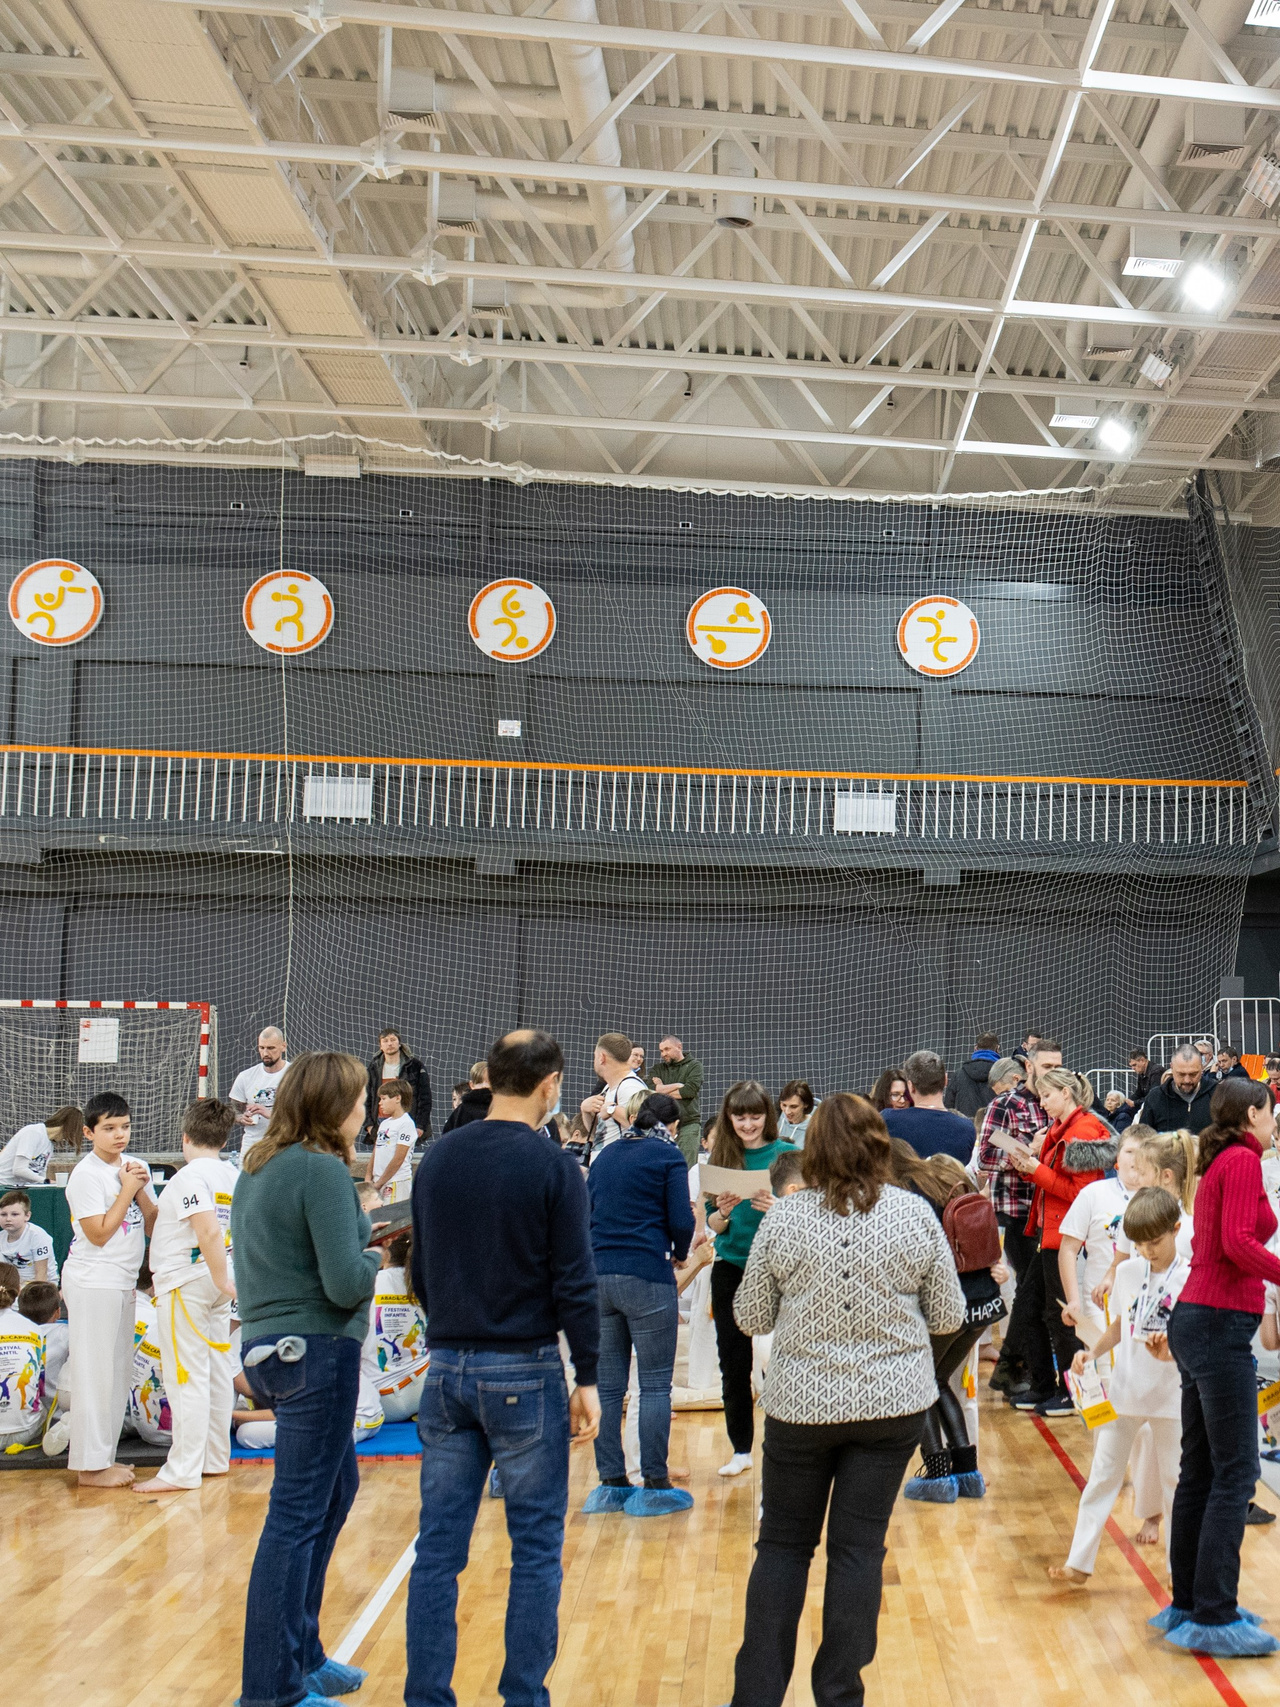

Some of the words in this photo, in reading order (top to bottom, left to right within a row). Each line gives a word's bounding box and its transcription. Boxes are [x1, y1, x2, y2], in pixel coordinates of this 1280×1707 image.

[400, 1133, 411, 1142] 86
[183, 1194, 199, 1209] 94
[36, 1246, 49, 1256] 63
